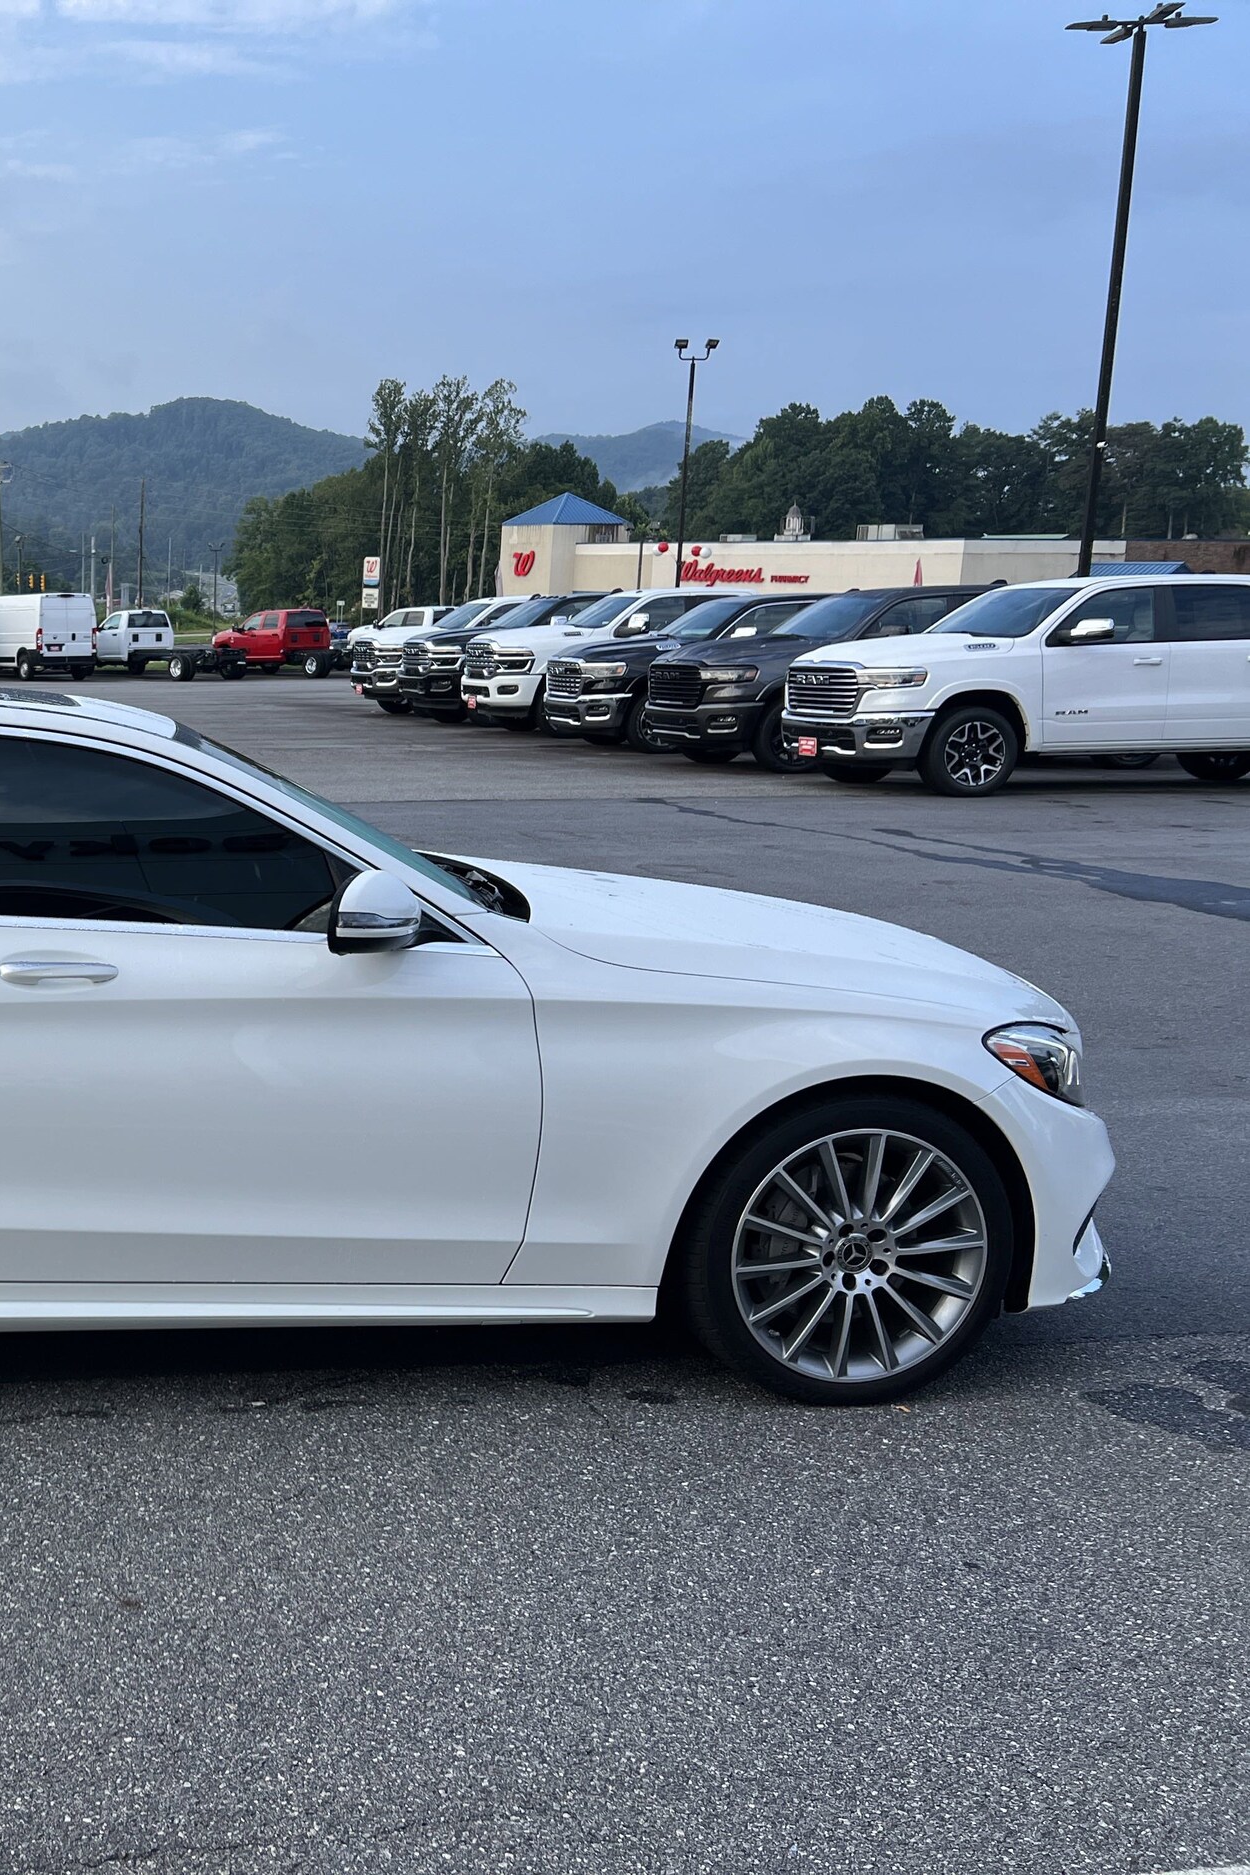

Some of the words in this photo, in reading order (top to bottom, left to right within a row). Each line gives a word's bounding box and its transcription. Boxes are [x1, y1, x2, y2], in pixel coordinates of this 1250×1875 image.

[513, 550, 536, 577] W
[680, 559, 765, 587] Walgreens
[796, 674, 830, 685] RAM
